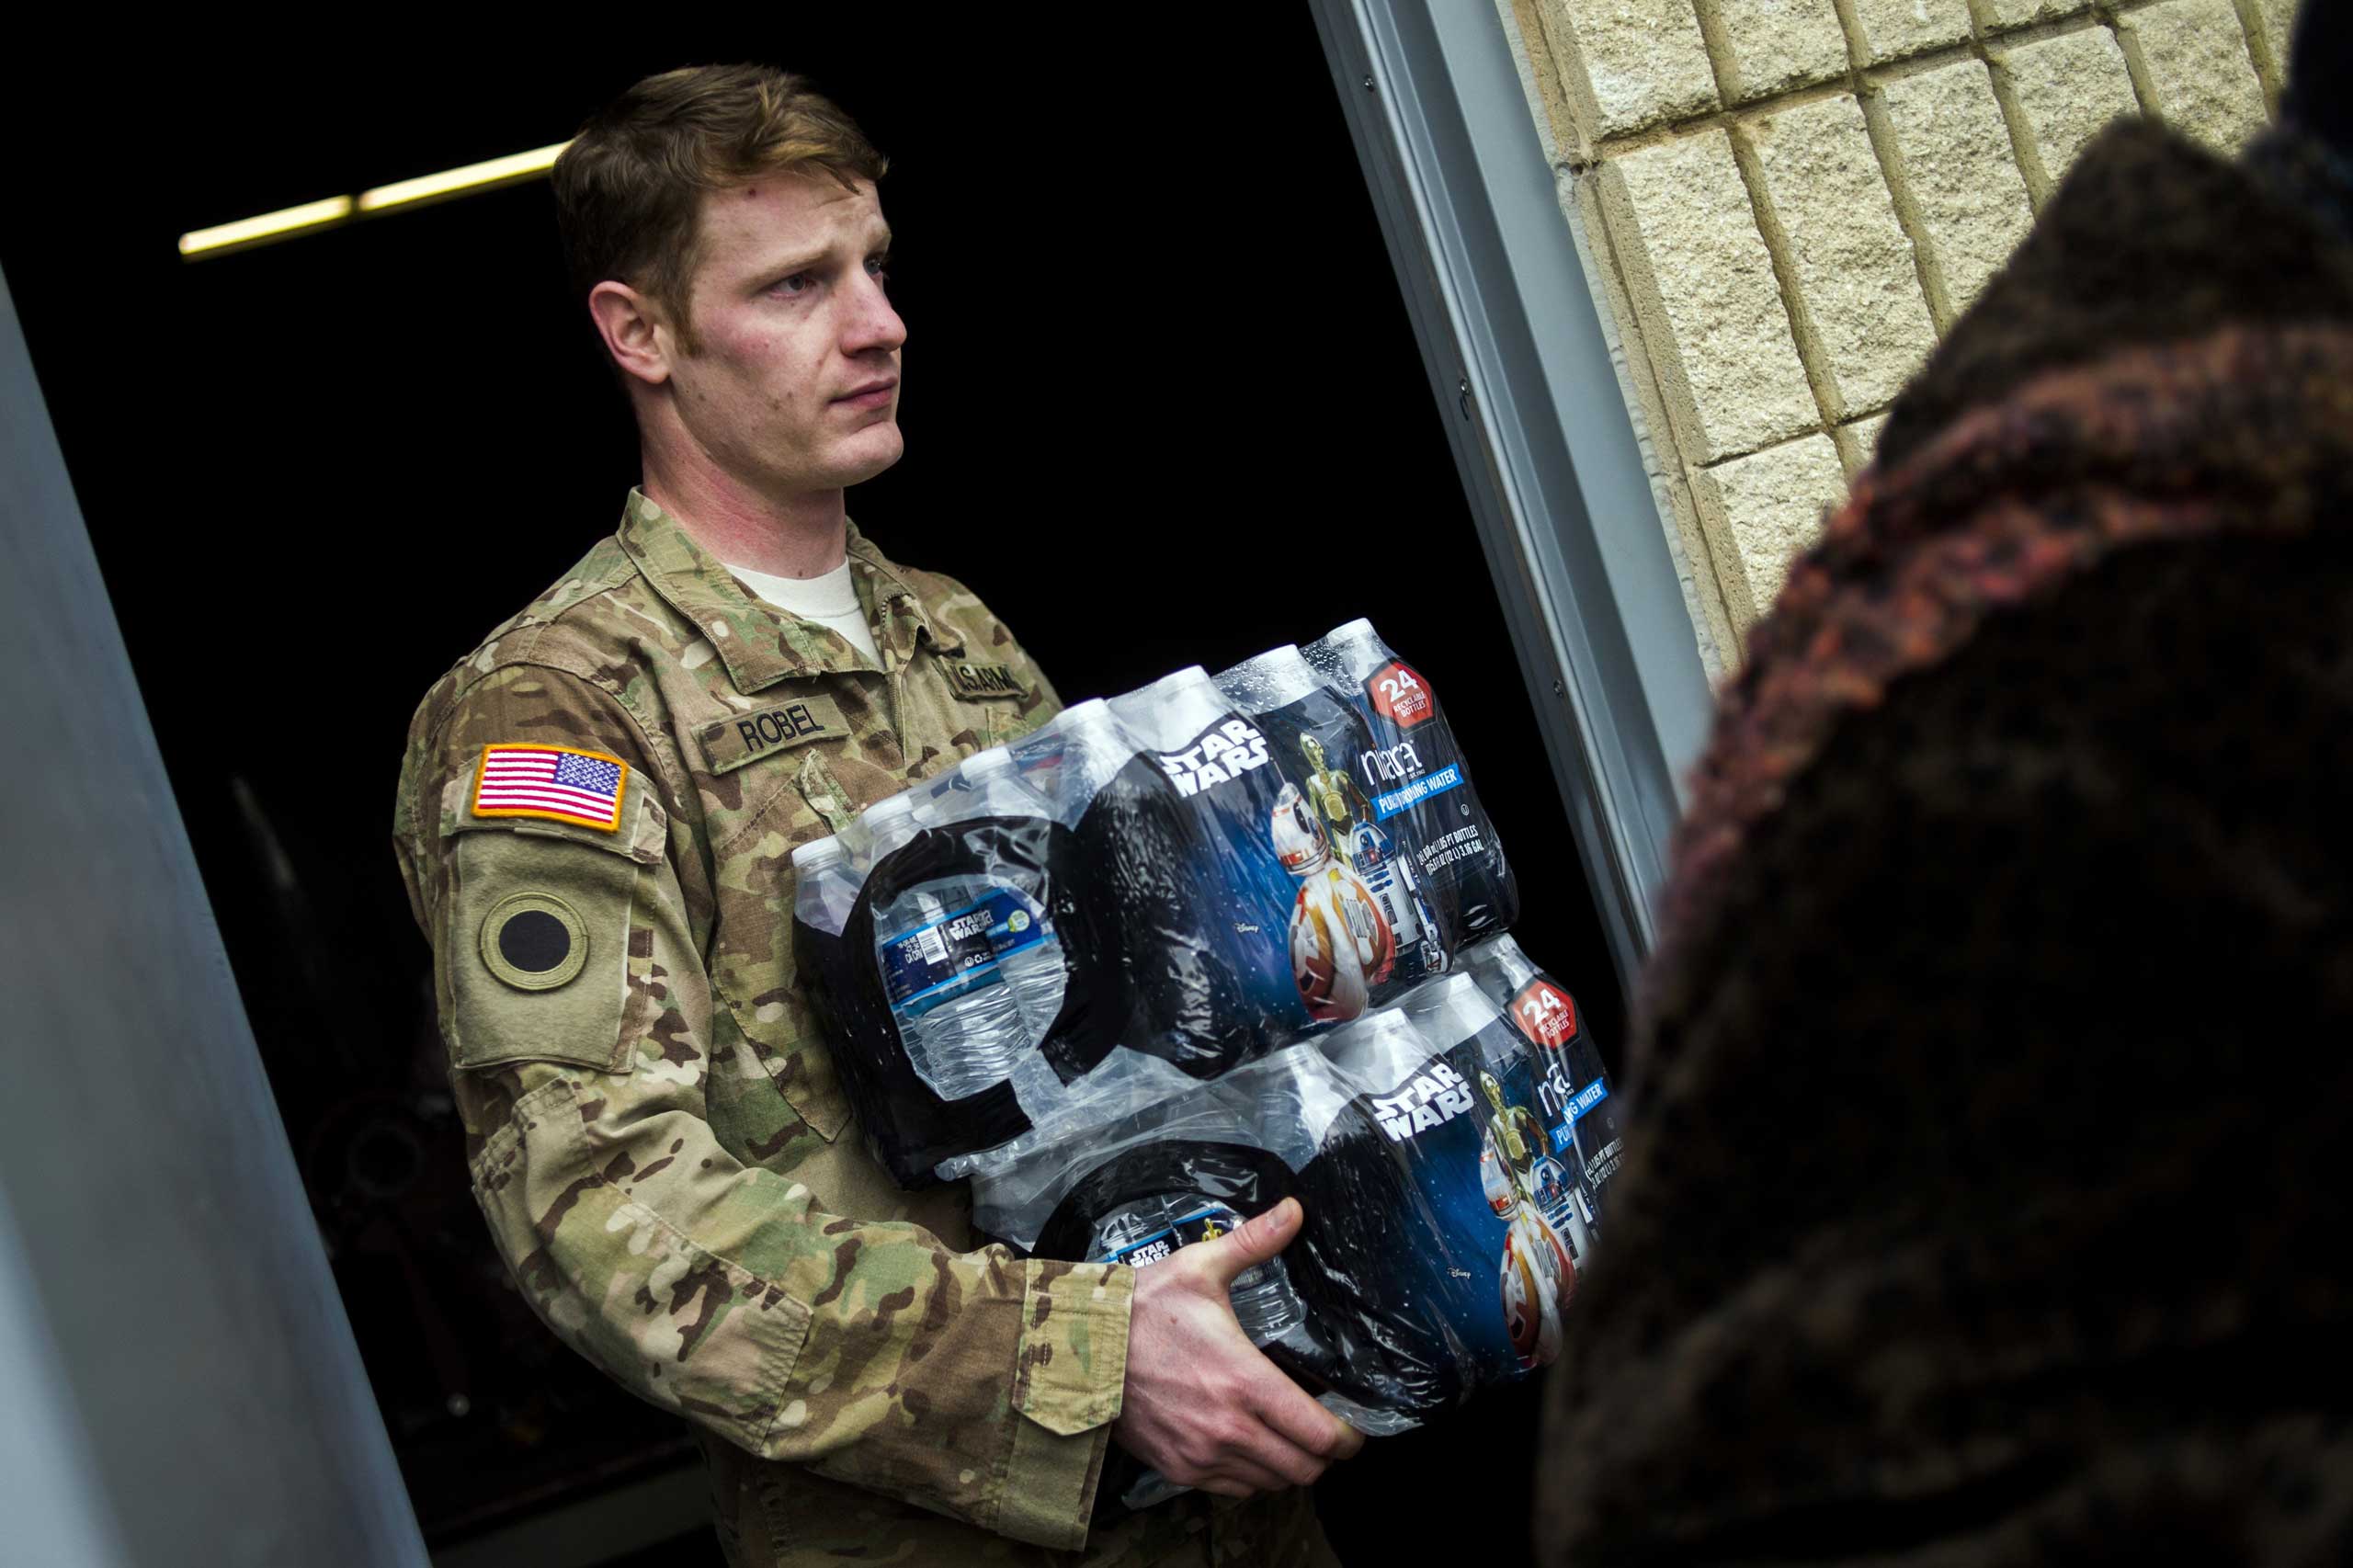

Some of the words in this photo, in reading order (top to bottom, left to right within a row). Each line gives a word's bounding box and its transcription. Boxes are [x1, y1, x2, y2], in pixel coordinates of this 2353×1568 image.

[1380, 669, 1418, 702] 24
[1393, 691, 1426, 712] RECYCLABLE
[1401, 700, 1427, 718] BOTTLES
[737, 704, 824, 752] ROBEL
[1159, 720, 1261, 775] STAR
[1169, 736, 1268, 797] WARS
[1427, 768, 1457, 791] WATER
[1452, 824, 1478, 843] BOTTLES
[1459, 843, 1472, 857] 3.16
[1471, 838, 1484, 853] GAL
[1523, 988, 1562, 1026] 24
[1371, 1063, 1463, 1121] STAR
[1576, 1084, 1603, 1109] WATER
[1380, 1081, 1474, 1142] WARS
[1132, 1241, 1169, 1259] STAR
